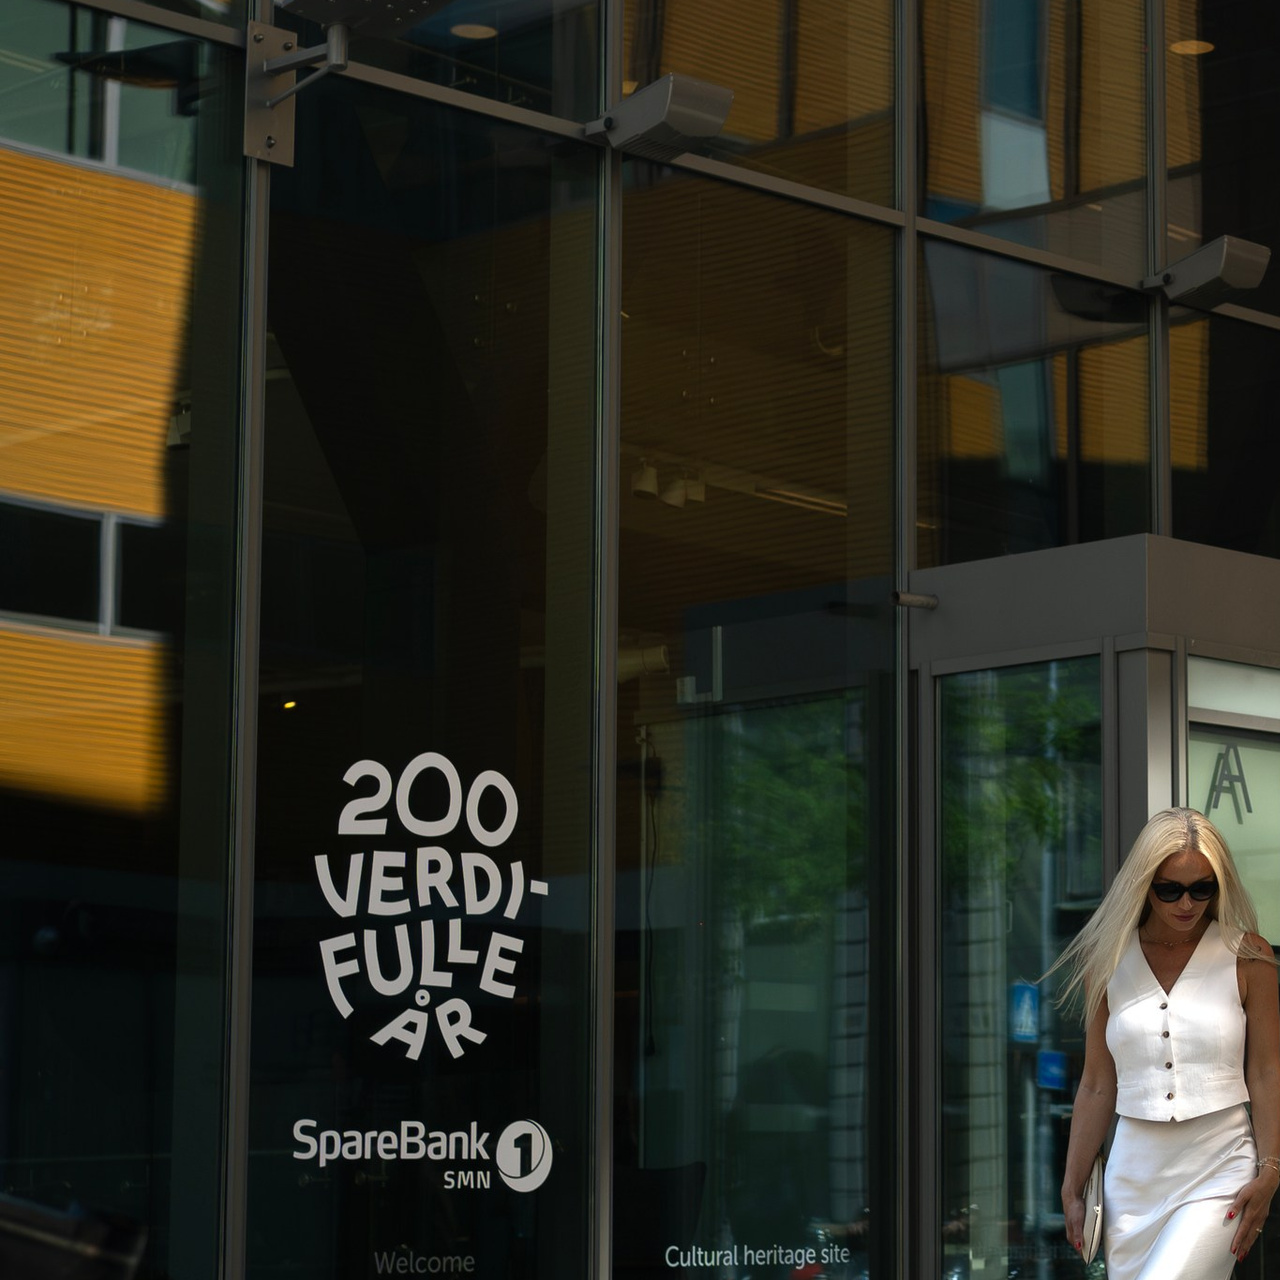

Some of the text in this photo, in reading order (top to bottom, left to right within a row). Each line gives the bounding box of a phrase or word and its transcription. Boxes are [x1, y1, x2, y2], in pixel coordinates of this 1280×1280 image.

[337, 751, 519, 847] 200
[315, 847, 549, 920] VERDI-
[319, 918, 525, 1020] FULLE
[369, 988, 488, 1061] ÅR
[292, 1119, 490, 1168] SpareBank
[443, 1170, 491, 1189] SMN
[374, 1250, 476, 1274] Welcome
[664, 1242, 851, 1270] Cultural heritage site
